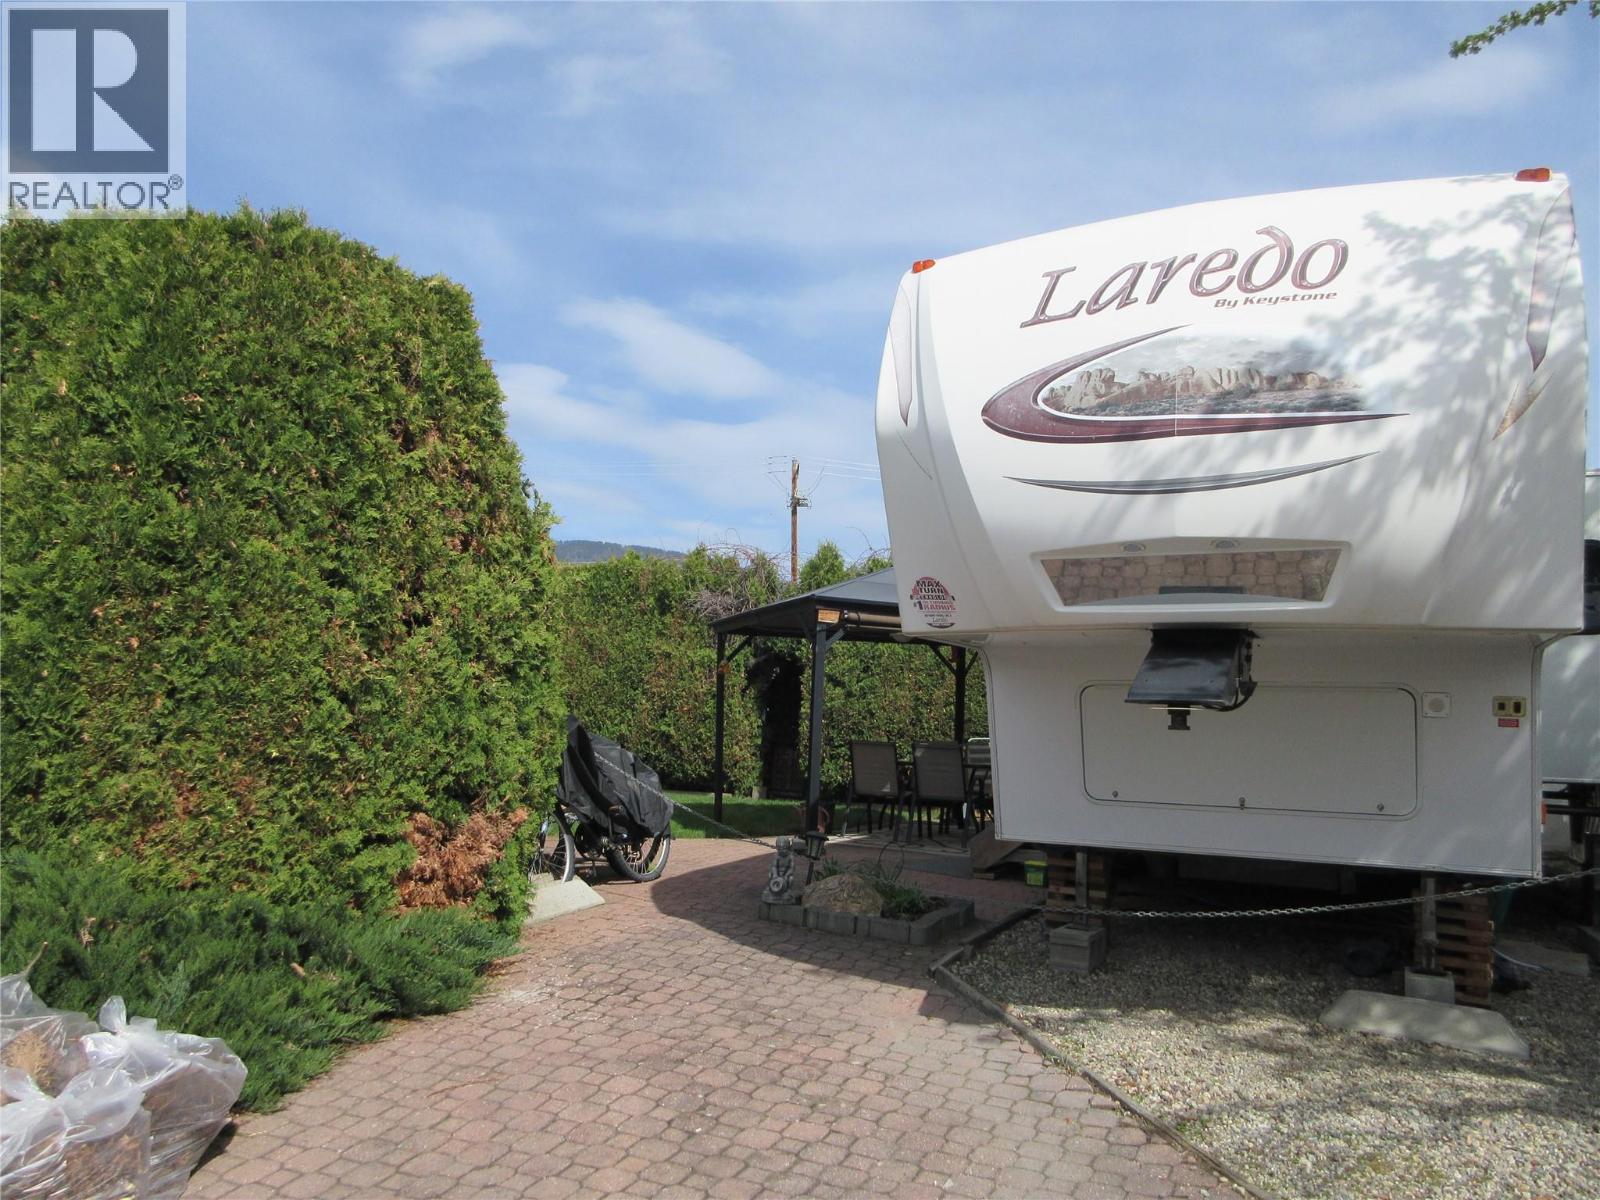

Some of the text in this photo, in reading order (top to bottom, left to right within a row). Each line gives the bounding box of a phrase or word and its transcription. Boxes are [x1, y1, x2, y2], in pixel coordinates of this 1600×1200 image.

[1020, 225, 1349, 328] Laredo
[1214, 292, 1337, 309] By Keystone
